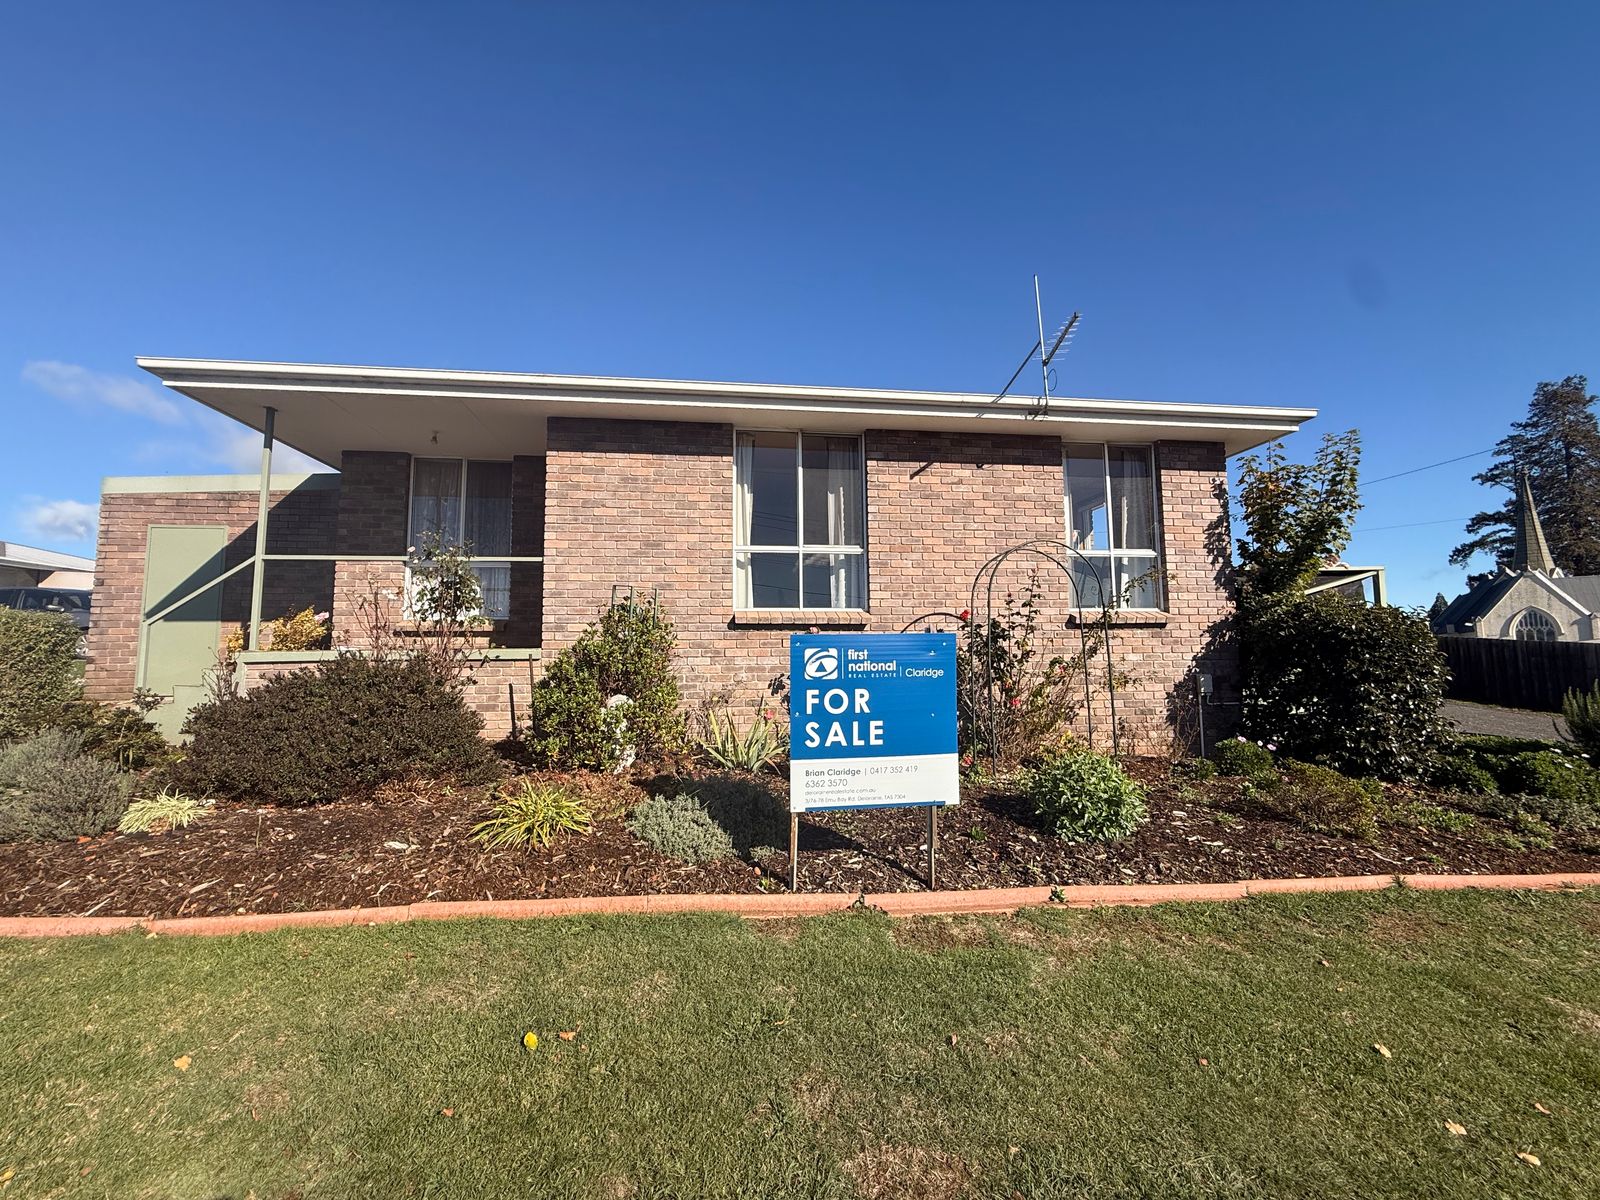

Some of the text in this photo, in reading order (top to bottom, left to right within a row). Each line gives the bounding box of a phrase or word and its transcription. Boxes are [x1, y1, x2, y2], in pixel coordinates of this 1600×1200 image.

[848, 649, 868, 660] first
[848, 660, 896, 671] national
[905, 668, 944, 678] Claridge
[806, 688, 870, 715] FOR
[804, 720, 884, 748] SALE
[805, 765, 918, 777] Brian Claridge 0417 352 419
[805, 779, 848, 788] 6362 3570
